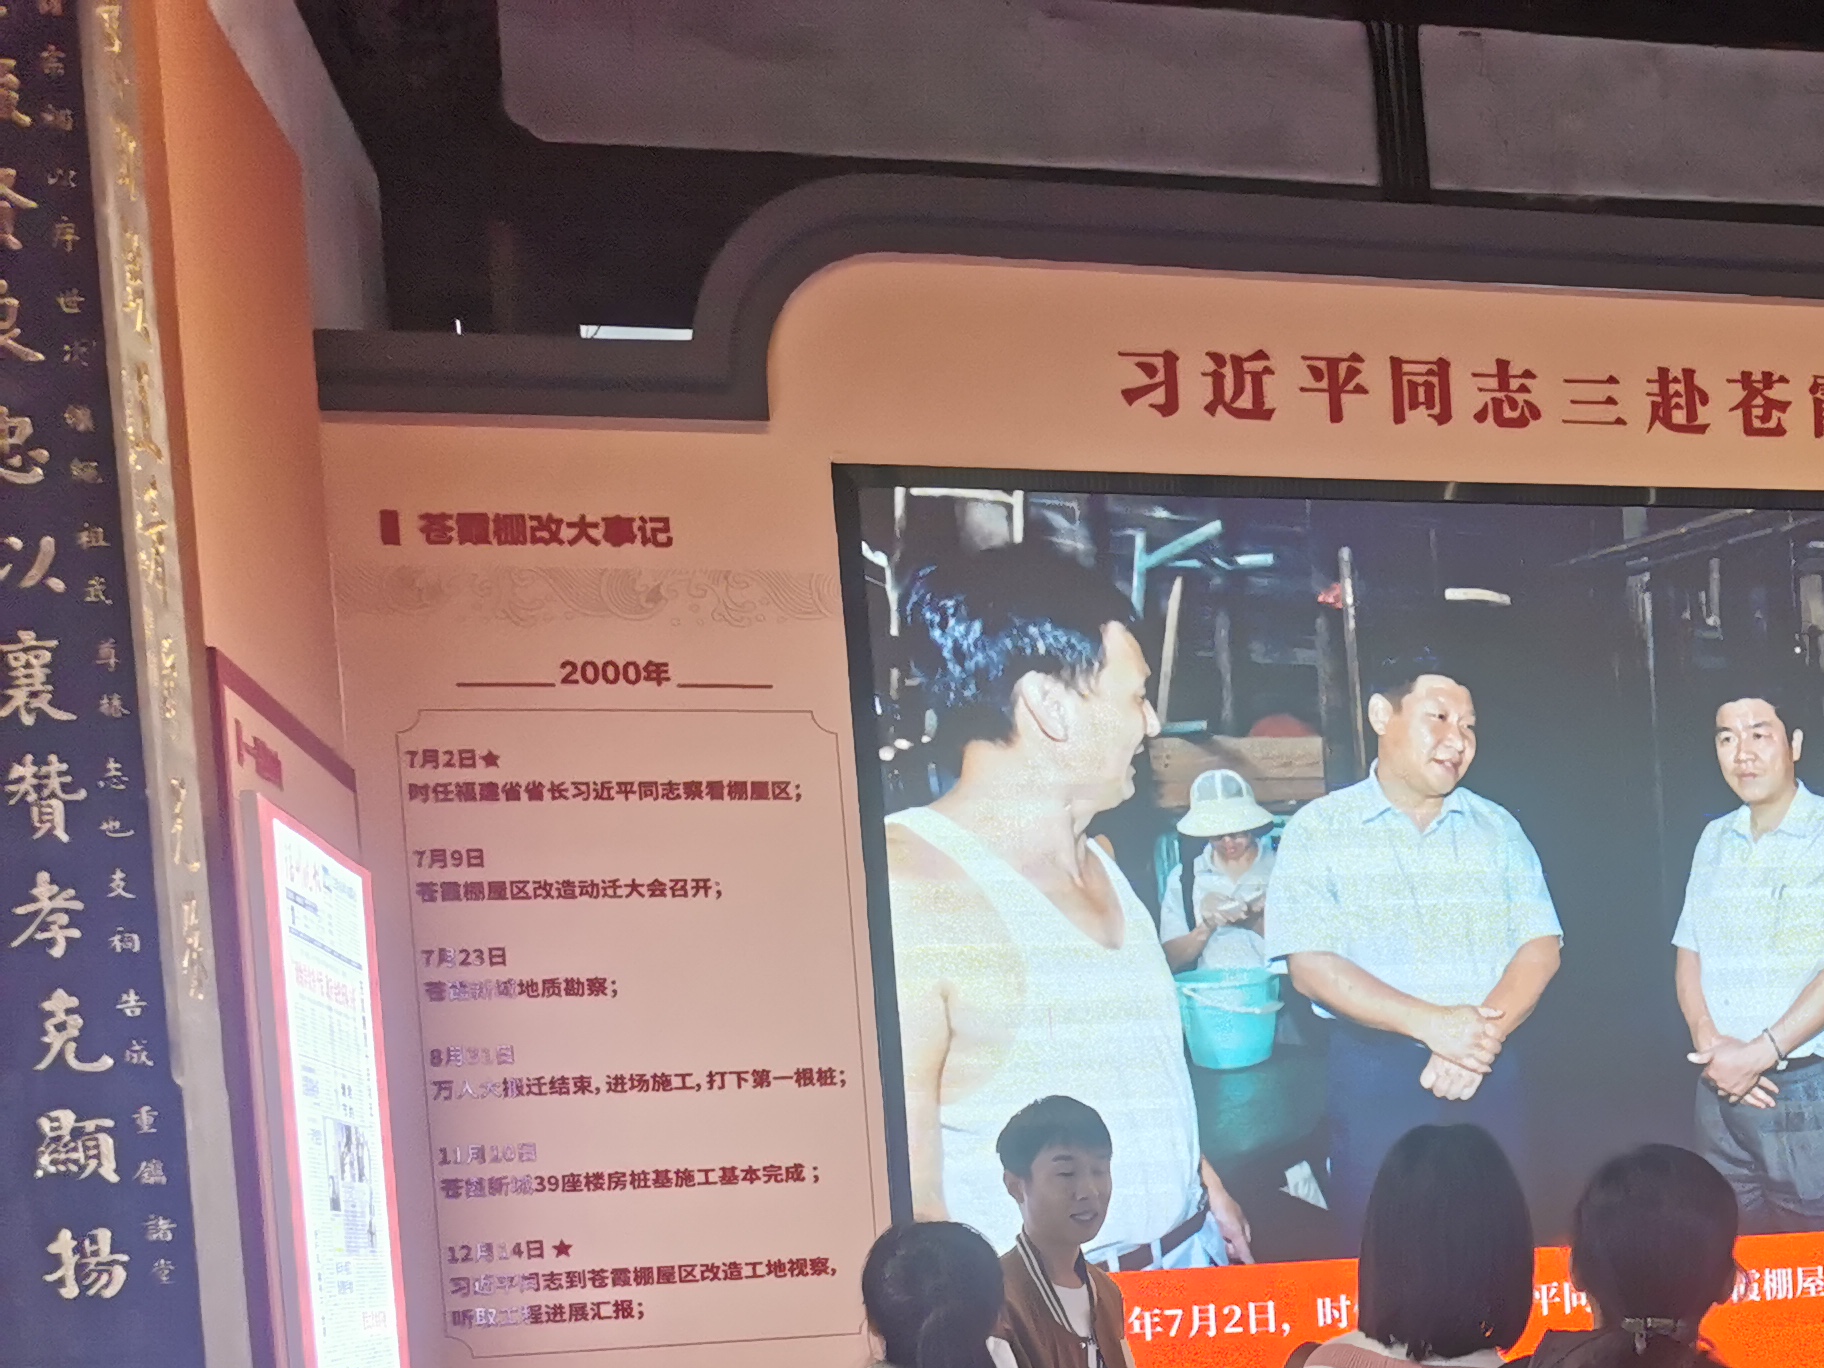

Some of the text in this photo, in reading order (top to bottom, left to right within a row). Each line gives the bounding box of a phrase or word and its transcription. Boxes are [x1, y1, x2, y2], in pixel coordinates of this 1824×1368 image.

[418, 512, 673, 549] 苍霞棚改大事记
[559, 659, 671, 687] 2000年
[406, 750, 477, 769] 7月2日
[413, 848, 485, 869] 7月9日
[421, 947, 507, 968] 7月23日
[447, 1240, 545, 1264] 12月14日
[1128, 1294, 1358, 1341] 年7月2日，时
